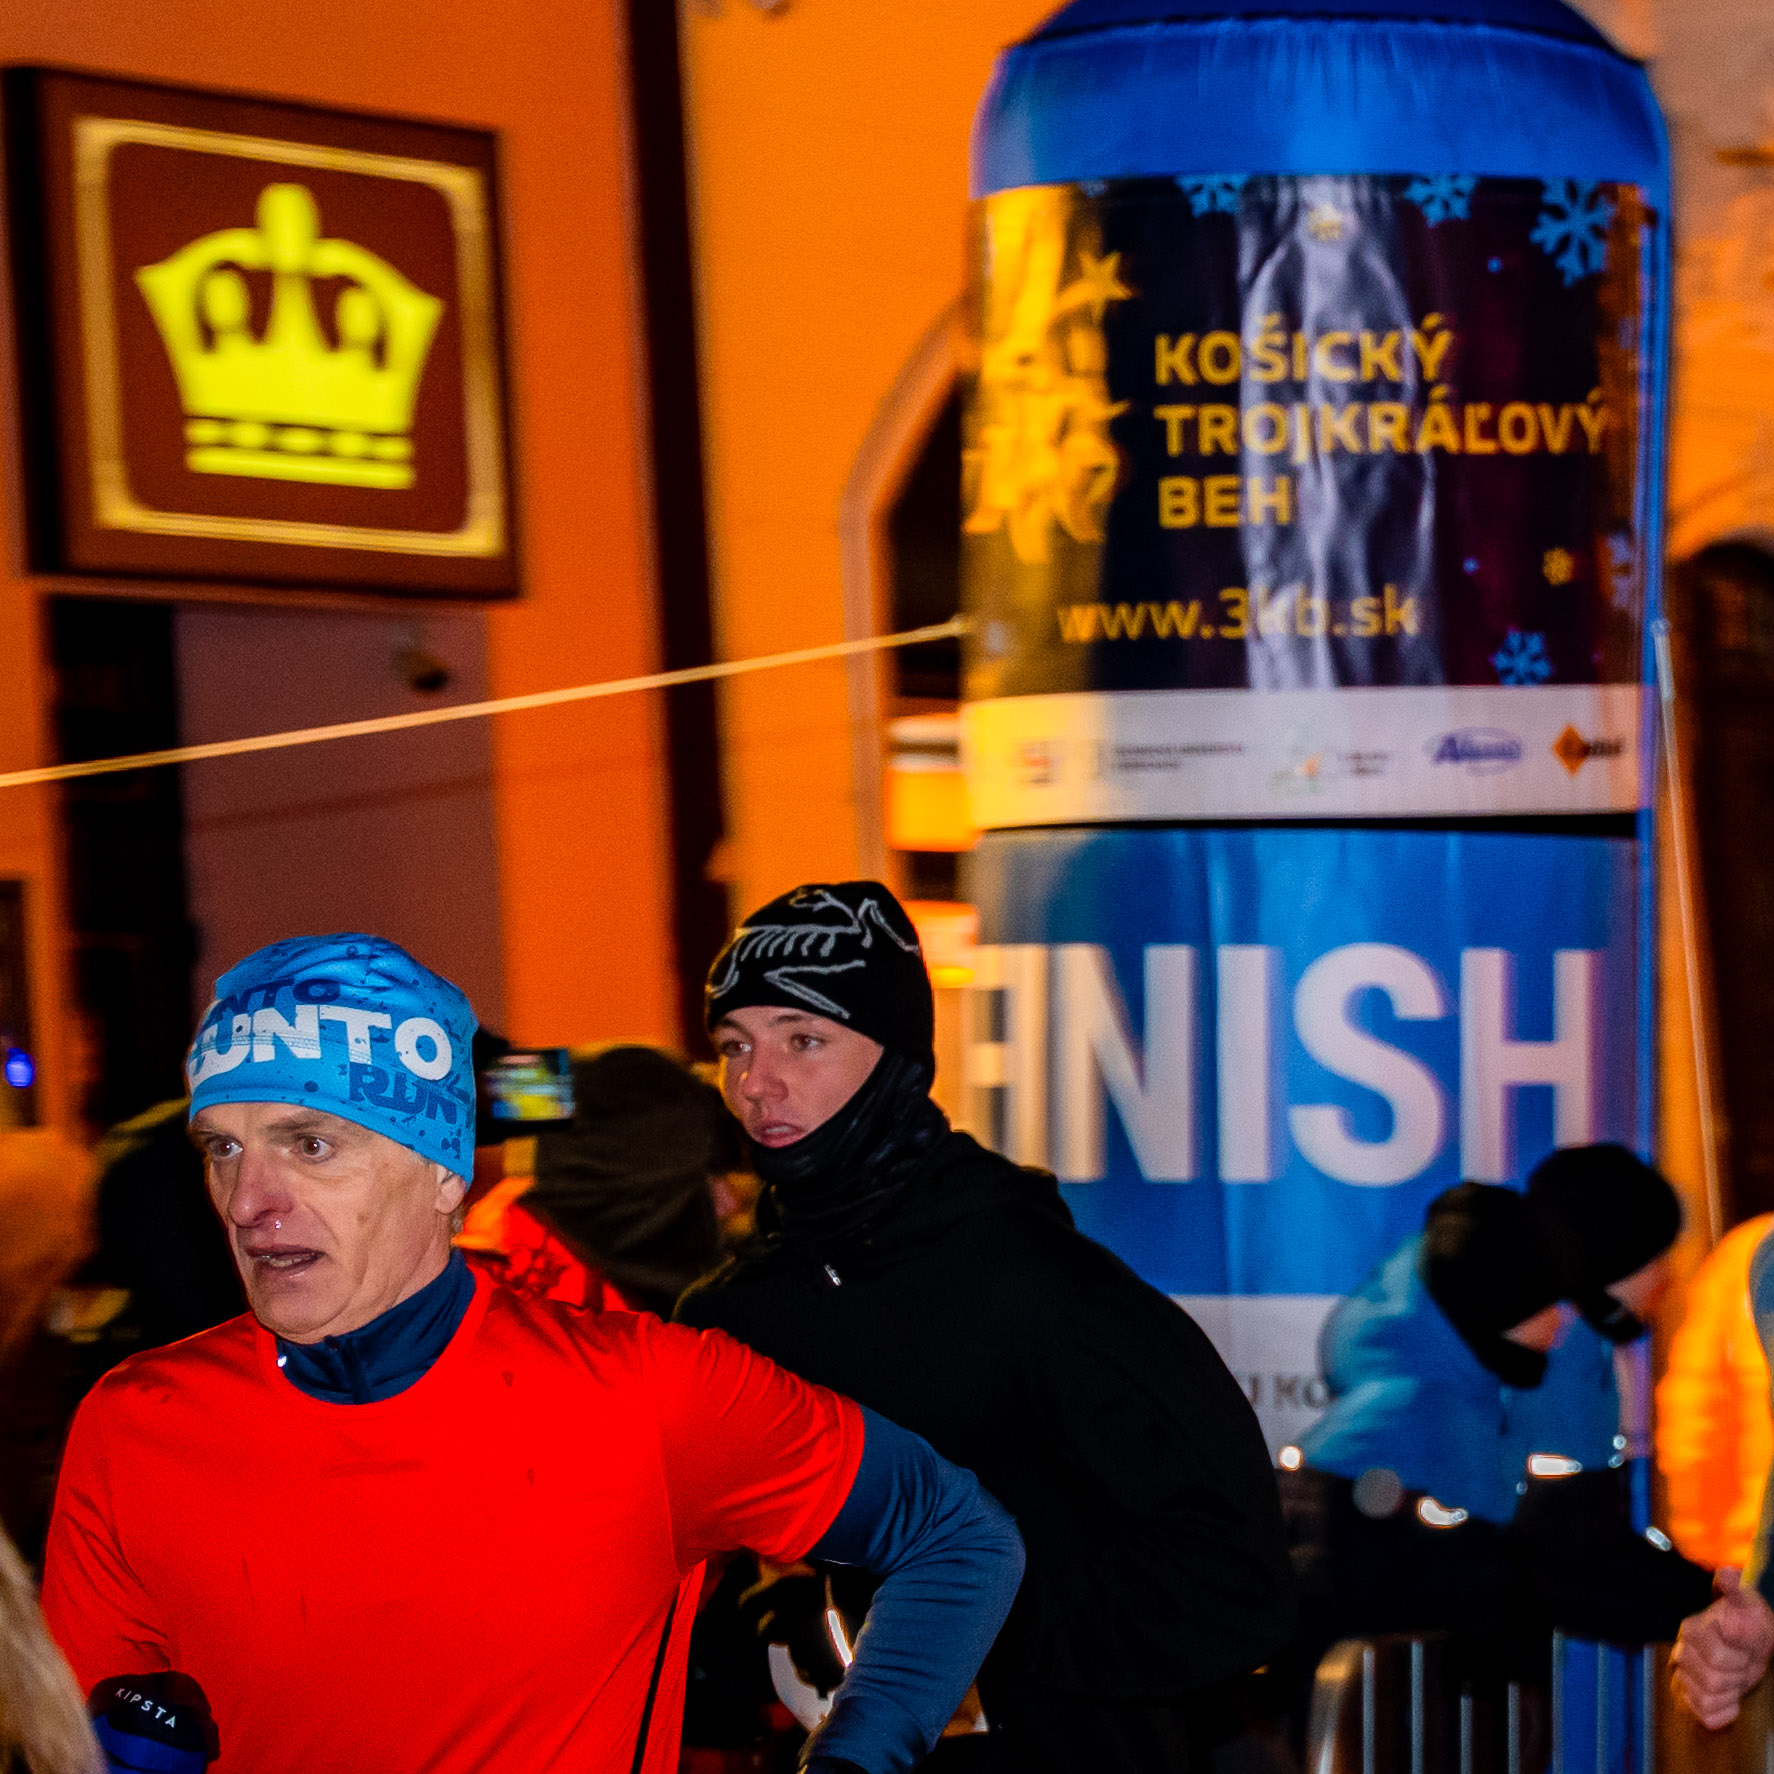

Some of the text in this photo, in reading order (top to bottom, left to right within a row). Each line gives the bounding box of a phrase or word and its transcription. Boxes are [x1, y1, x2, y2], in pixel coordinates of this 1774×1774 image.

[1153, 312, 1456, 386] KOŠICKÝ
[1152, 383, 1610, 466] TROJKRÁĽOVÝ
[1157, 474, 1292, 529] BEH
